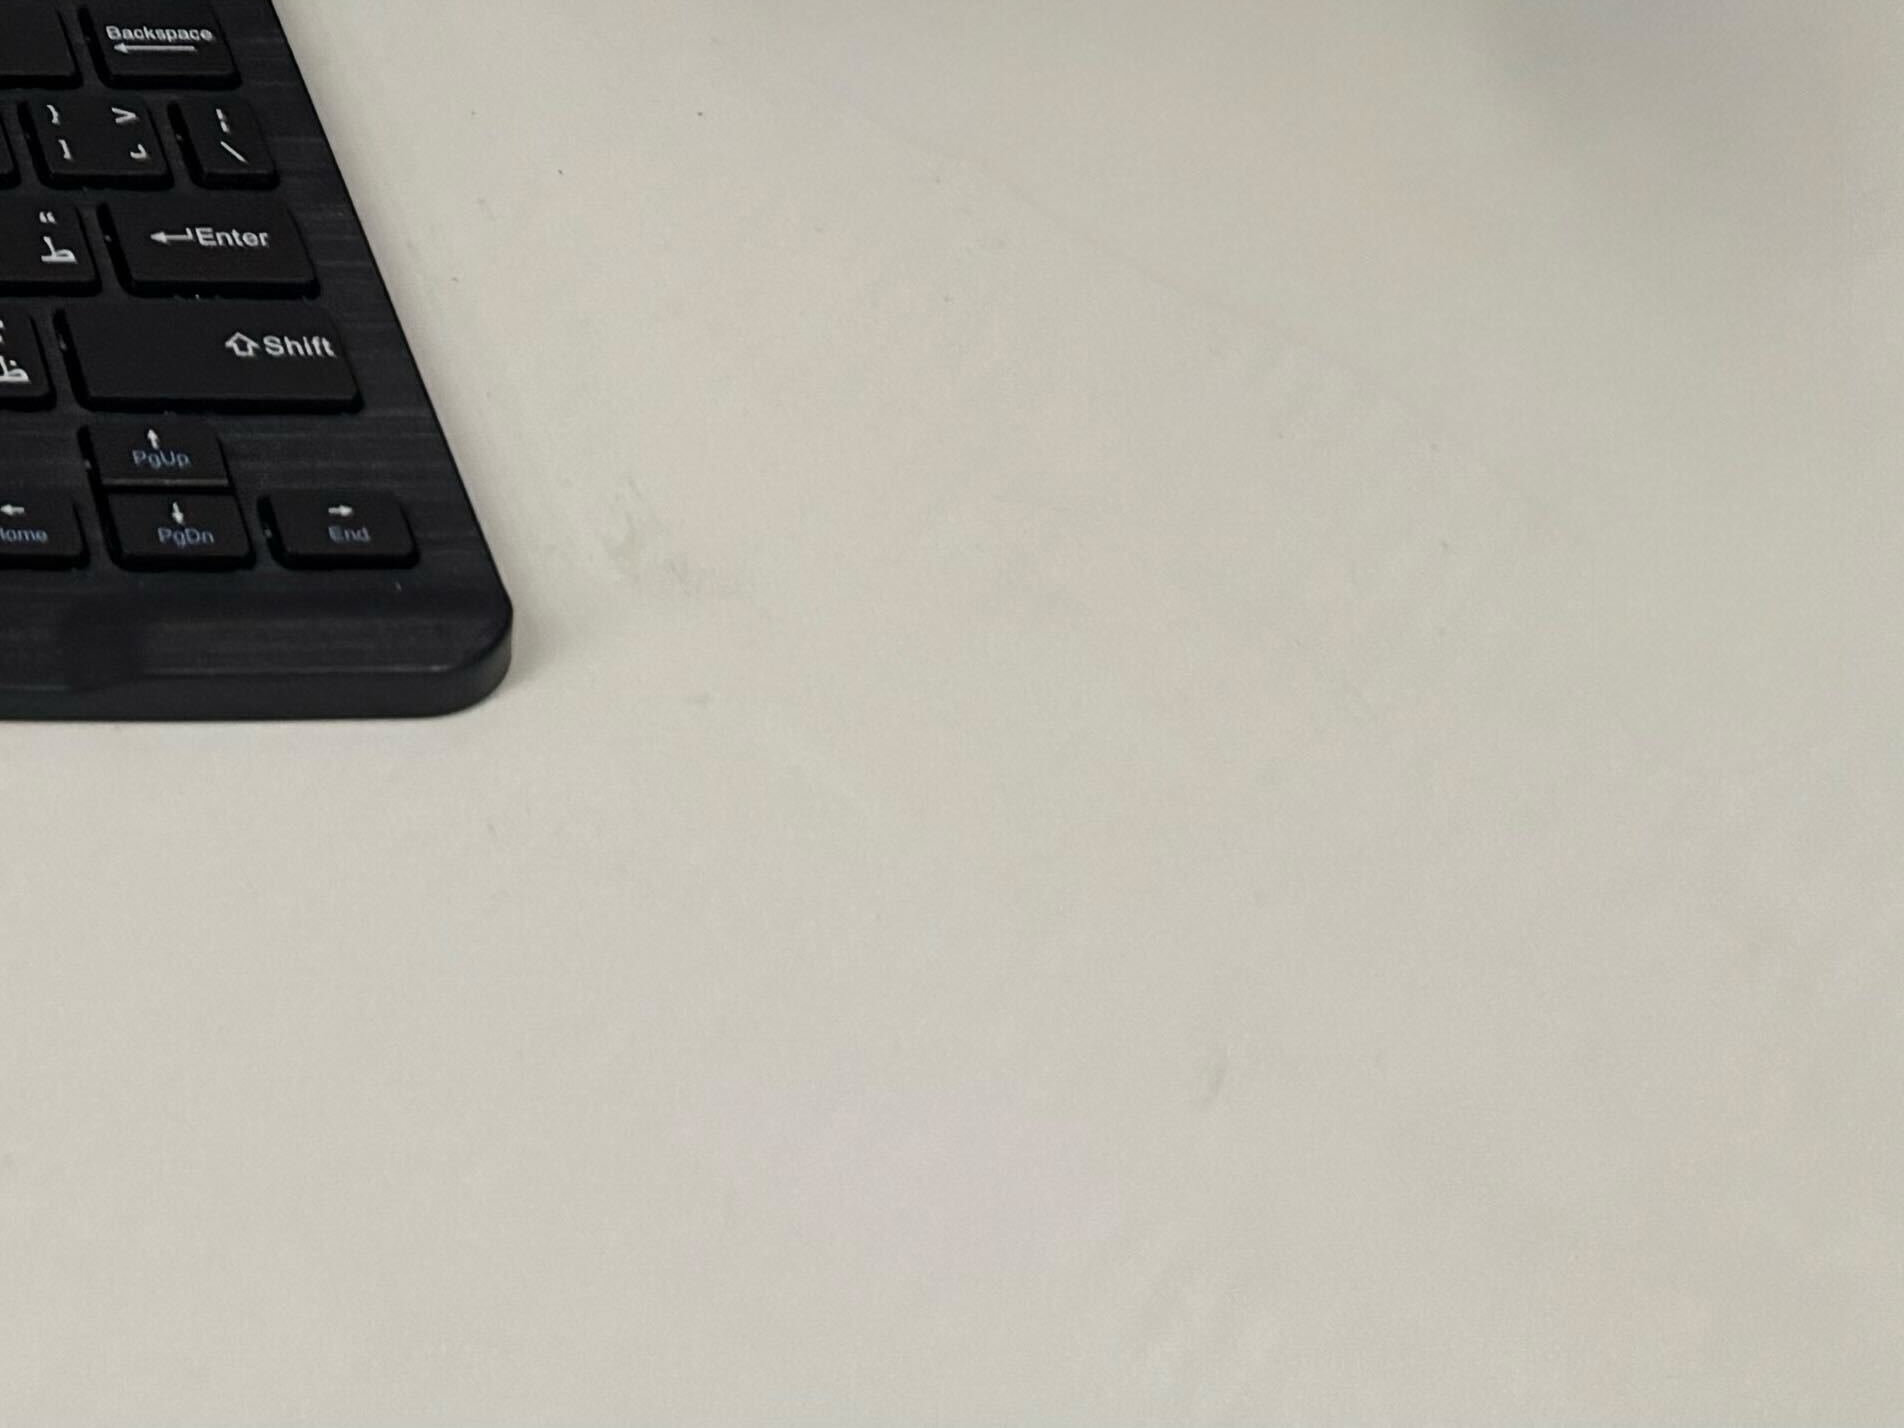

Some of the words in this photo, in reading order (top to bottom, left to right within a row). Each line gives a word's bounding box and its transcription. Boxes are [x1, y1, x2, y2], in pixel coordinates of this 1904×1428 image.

[106, 26, 213, 42] Backspace
[196, 228, 268, 246] Enter
[263, 336, 334, 356] Shift
[329, 526, 370, 542] End
